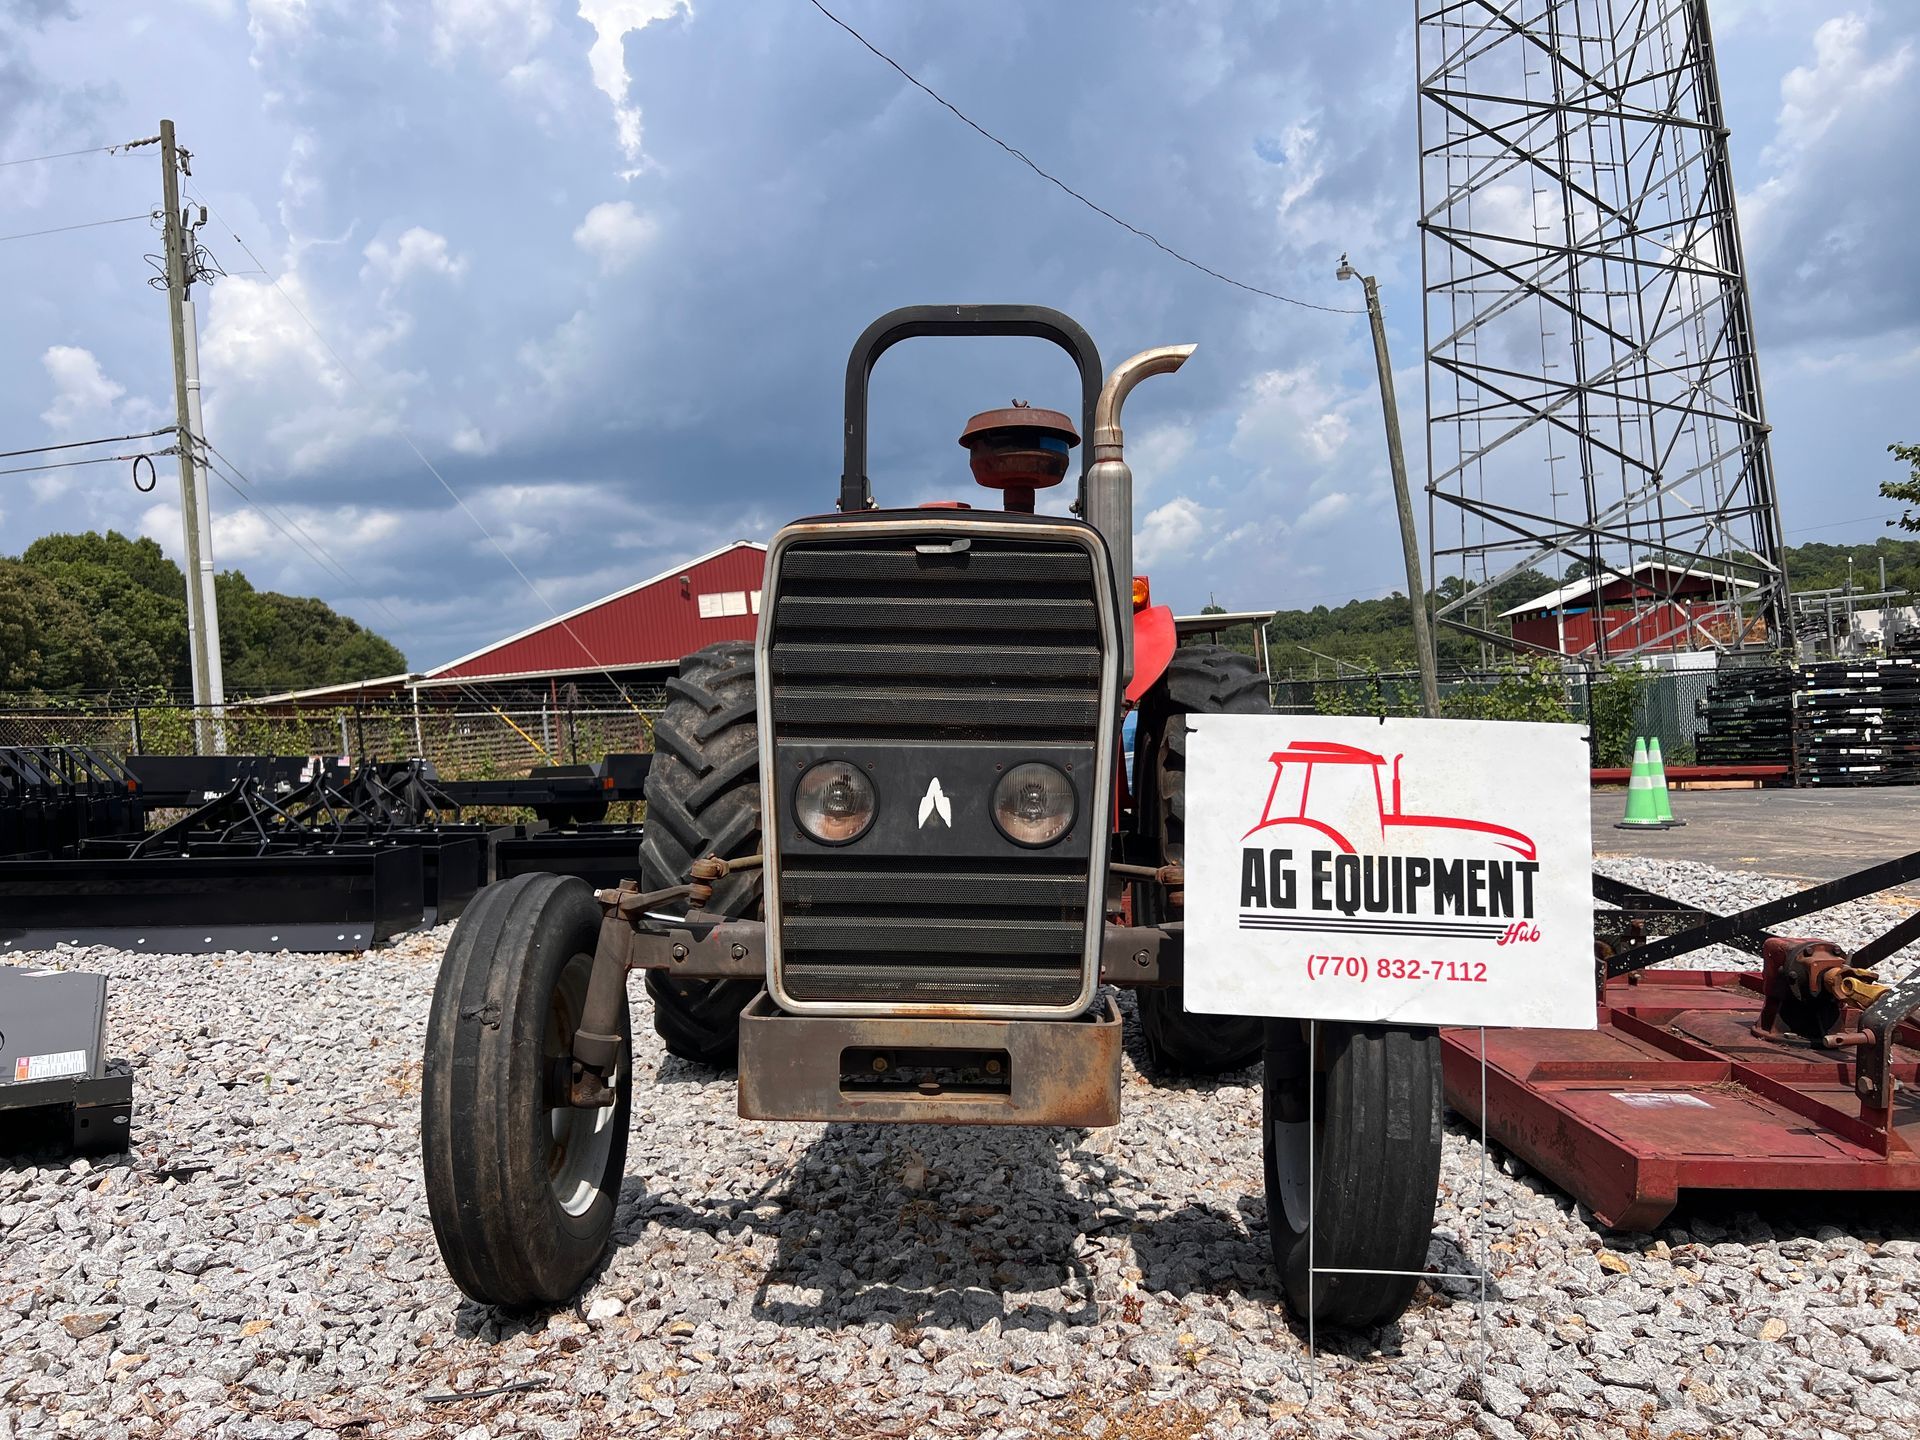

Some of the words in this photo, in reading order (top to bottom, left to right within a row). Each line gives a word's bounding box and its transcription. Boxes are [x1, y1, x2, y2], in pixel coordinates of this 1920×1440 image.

[1240, 847, 1297, 910] AG
[1312, 850, 1540, 919] EQUIPMENT
[1496, 921, 1541, 946] Hub
[1306, 955, 1368, 983] (770)
[1377, 957, 1488, 983] 832-7112
